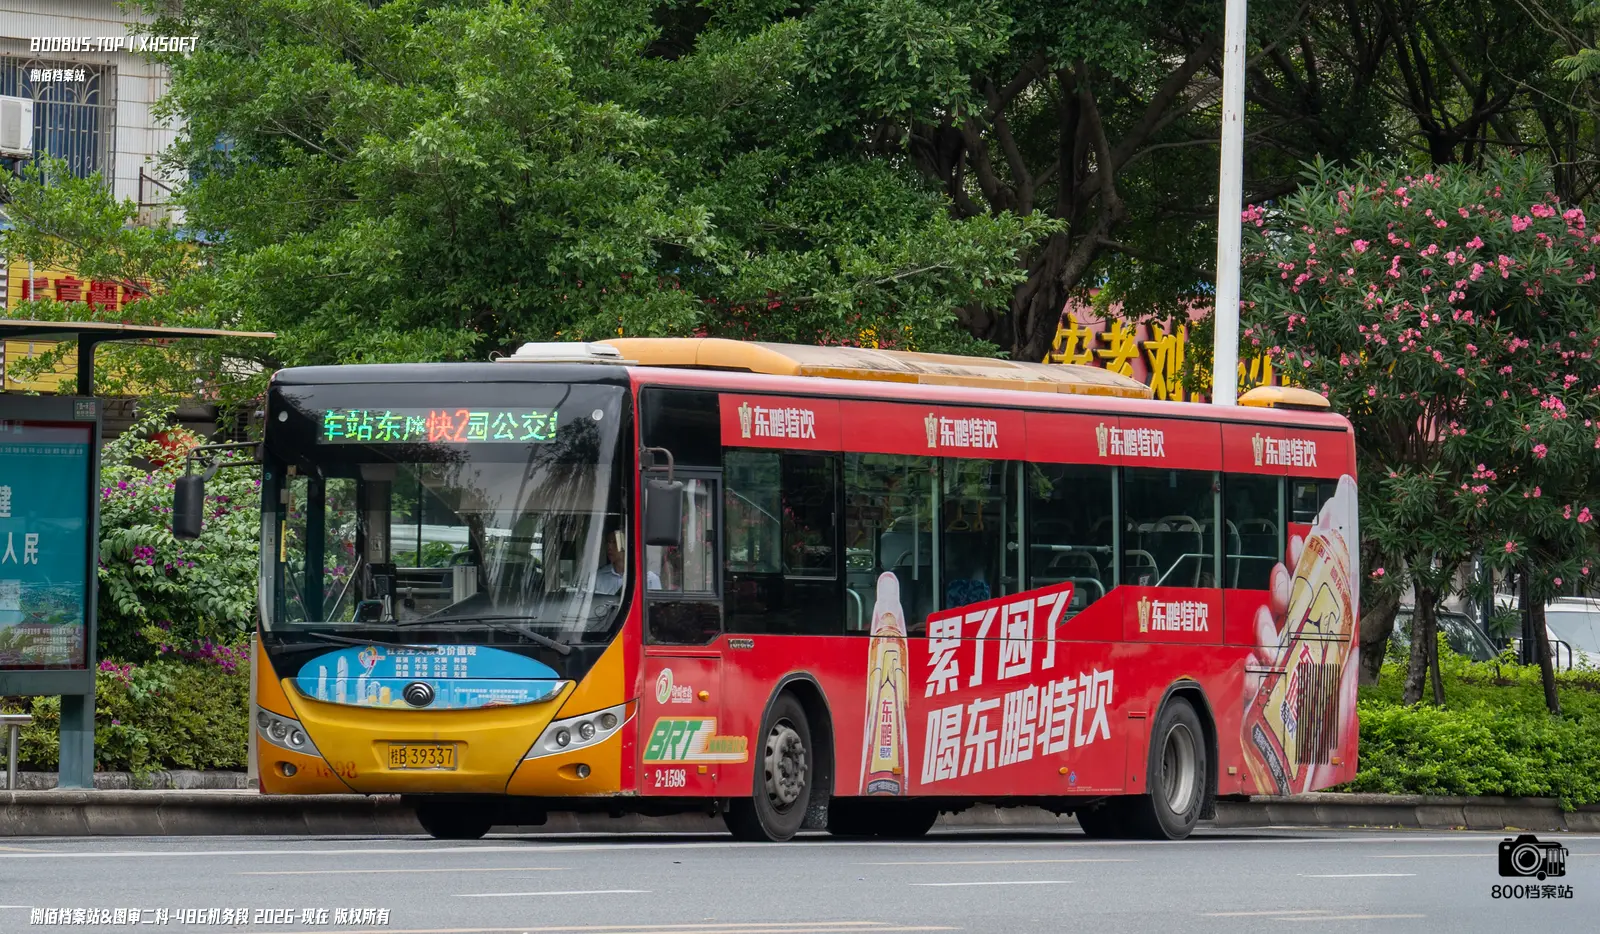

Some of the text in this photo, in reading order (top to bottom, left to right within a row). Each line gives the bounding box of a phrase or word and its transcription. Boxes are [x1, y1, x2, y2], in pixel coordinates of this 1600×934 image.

[753, 405, 816, 440] 东鹏特饮
[939, 416, 999, 449] 东鹏特饮
[1109, 425, 1166, 458] 东鹏特饮
[1265, 436, 1318, 468] 东鹏特饮
[1, 532, 39, 565] 人民
[1151, 599, 1209, 632] 东鹏特饮
[924, 589, 1071, 698] 累了困了
[643, 719, 704, 761] BRT
[920, 667, 1114, 785] 喝东鹏特饮
